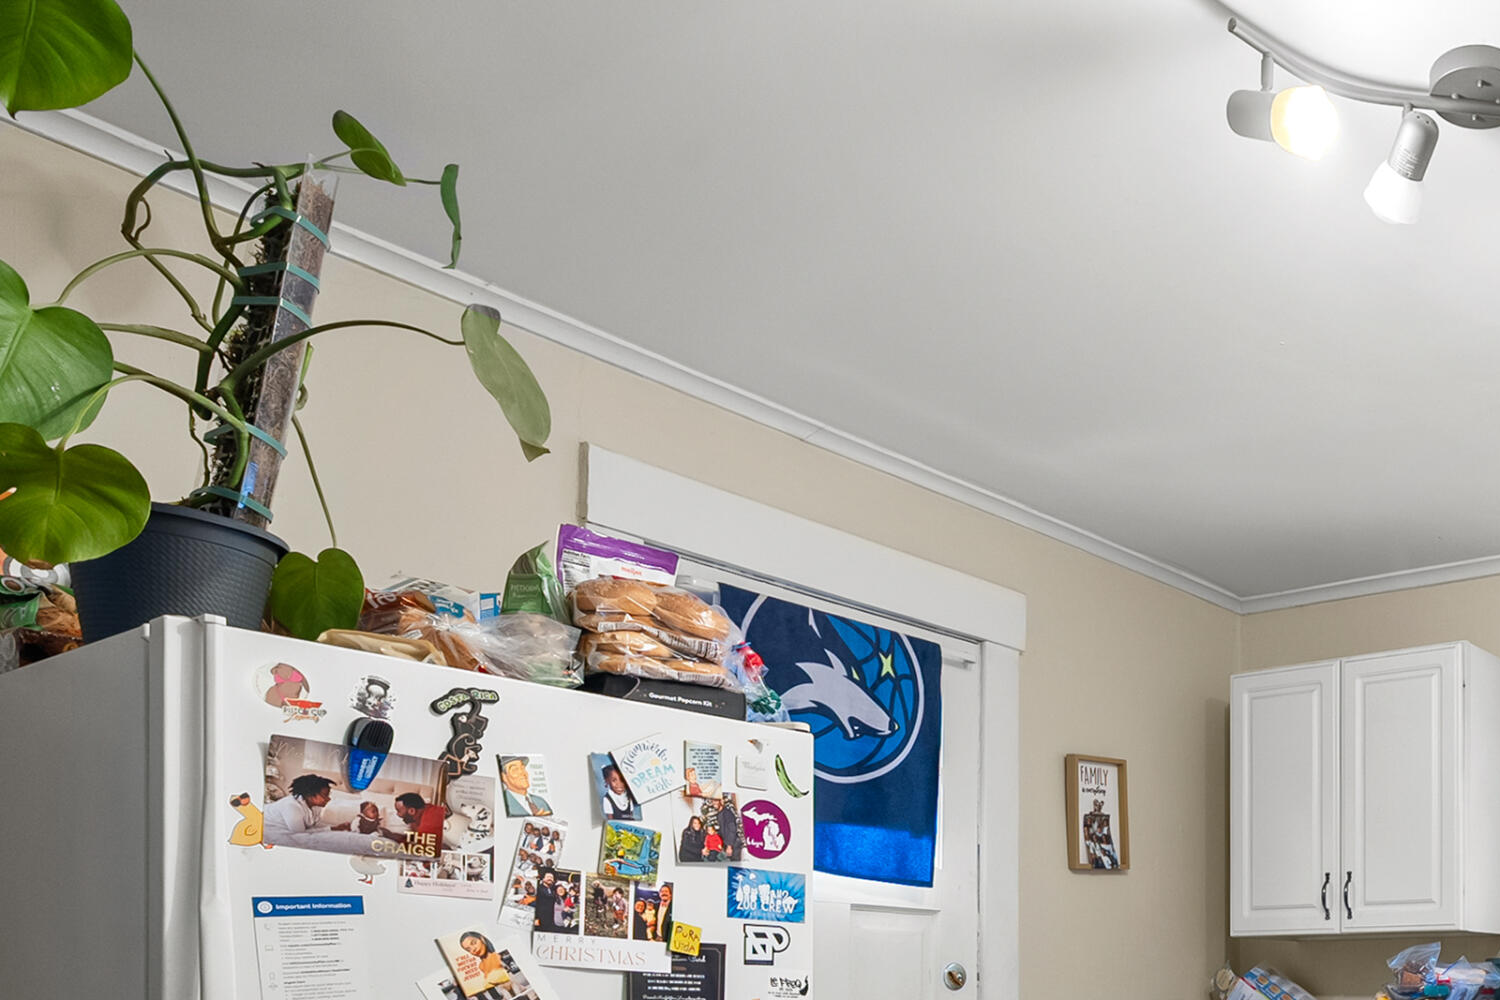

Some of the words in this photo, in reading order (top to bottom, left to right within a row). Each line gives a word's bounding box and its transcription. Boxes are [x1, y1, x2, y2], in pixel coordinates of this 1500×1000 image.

[436, 692, 470, 712] COSTA
[471, 689, 499, 702] RICA
[648, 692, 676, 702] Gourmet
[677, 696, 702, 705] Popcorn
[703, 700, 713, 708] Kit
[631, 763, 676, 788] DREAM
[1080, 765, 1109, 787] FAMILY
[404, 830, 437, 846] THE
[370, 839, 437, 858] CRAIGS
[275, 903, 311, 911] Important
[312, 902, 353, 910] Information
[760, 900, 798, 914] CREW
[536, 933, 598, 946] MERRY
[536, 944, 648, 966] CHRISTMAS
